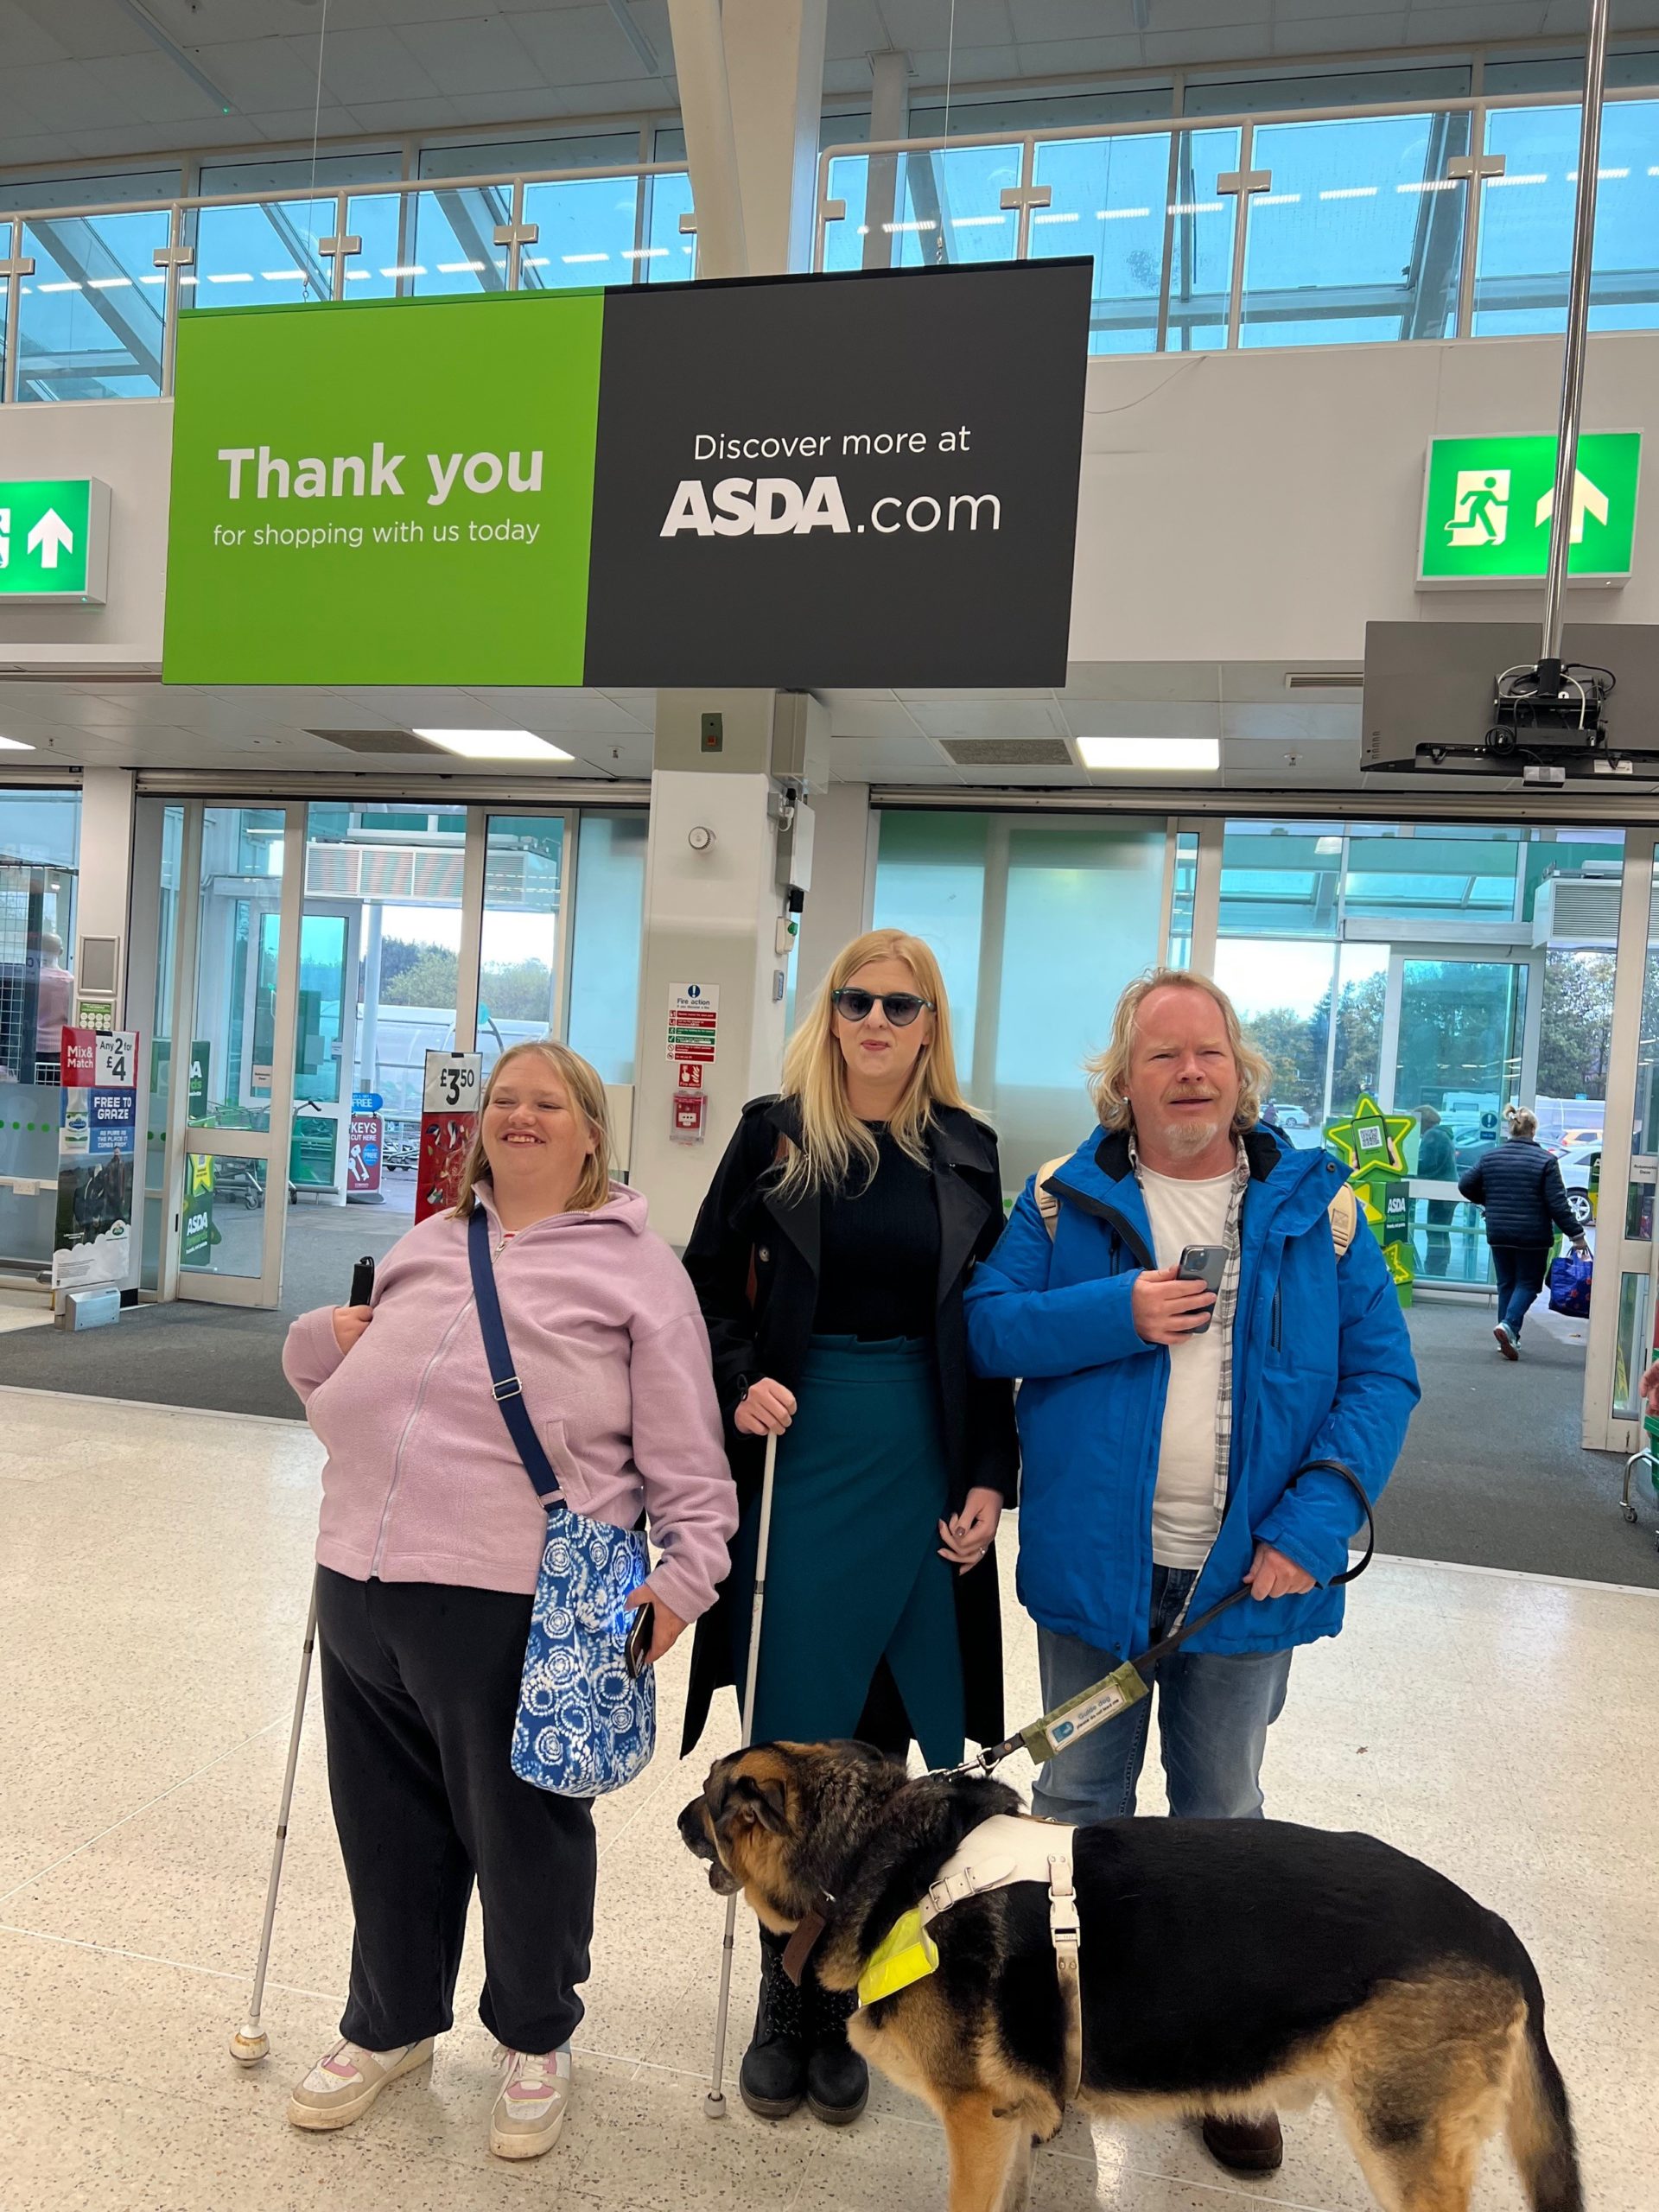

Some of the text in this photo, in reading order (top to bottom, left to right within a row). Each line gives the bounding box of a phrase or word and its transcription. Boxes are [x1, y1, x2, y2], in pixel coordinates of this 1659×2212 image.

[694, 425, 971, 461] Discover more at
[218, 442, 543, 505] Thank you
[659, 476, 1002, 537] ASDA.com
[213, 518, 540, 548] for shopping with us today
[100, 1041, 114, 1051] Any
[115, 1038, 123, 1054] 2
[67, 1058, 93, 1068] Match
[106, 1056, 126, 1081] £4
[94, 1096, 131, 1108] FREE TO
[98, 1109, 129, 1120] GRAZE
[351, 1122, 377, 1134] KEYS
[1388, 1198, 1406, 1213] ASDA
[187, 1211, 207, 1236] ASDA
[1078, 1696, 1111, 1719] Guide dog
